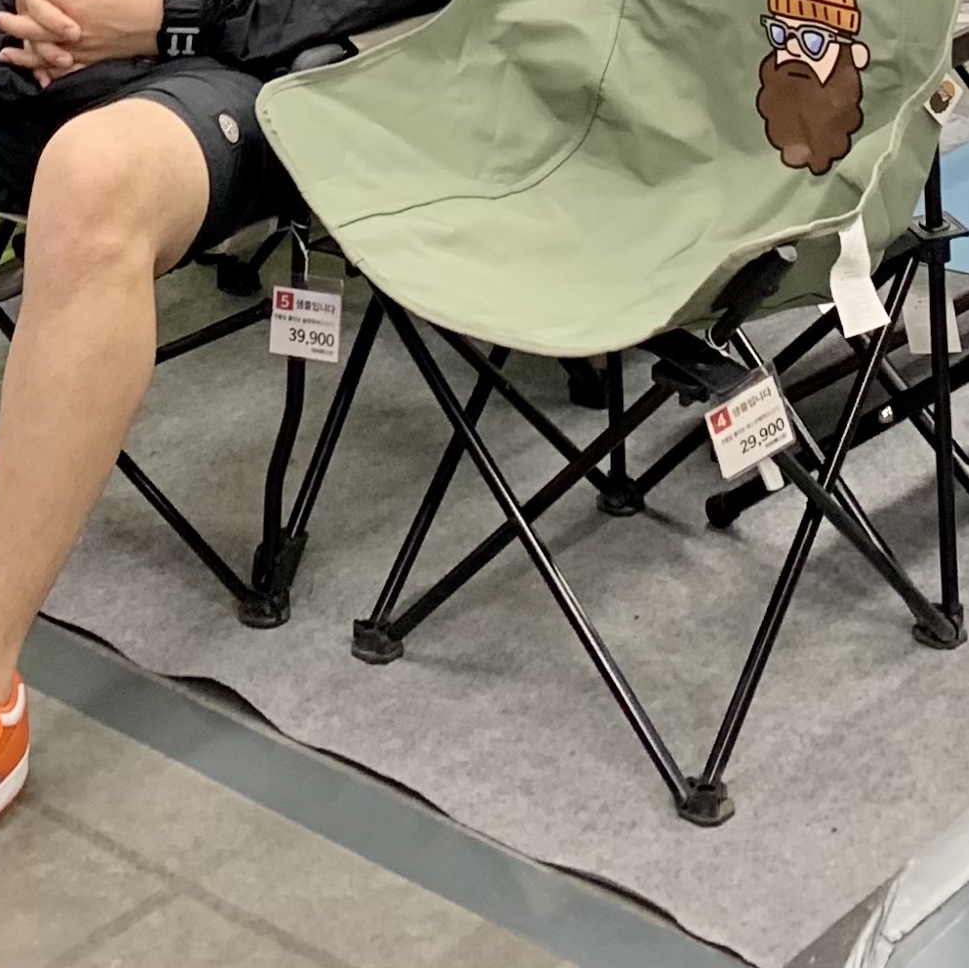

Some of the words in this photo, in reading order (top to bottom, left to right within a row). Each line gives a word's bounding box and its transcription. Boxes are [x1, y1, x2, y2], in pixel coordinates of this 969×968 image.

[280, 294, 290, 309] 5
[296, 299, 336, 314] 샘플입니다
[288, 327, 335, 348] 39,900
[717, 412, 728, 428] 4
[732, 386, 772, 418] 샘플입니다
[739, 417, 785, 454] 29,900
